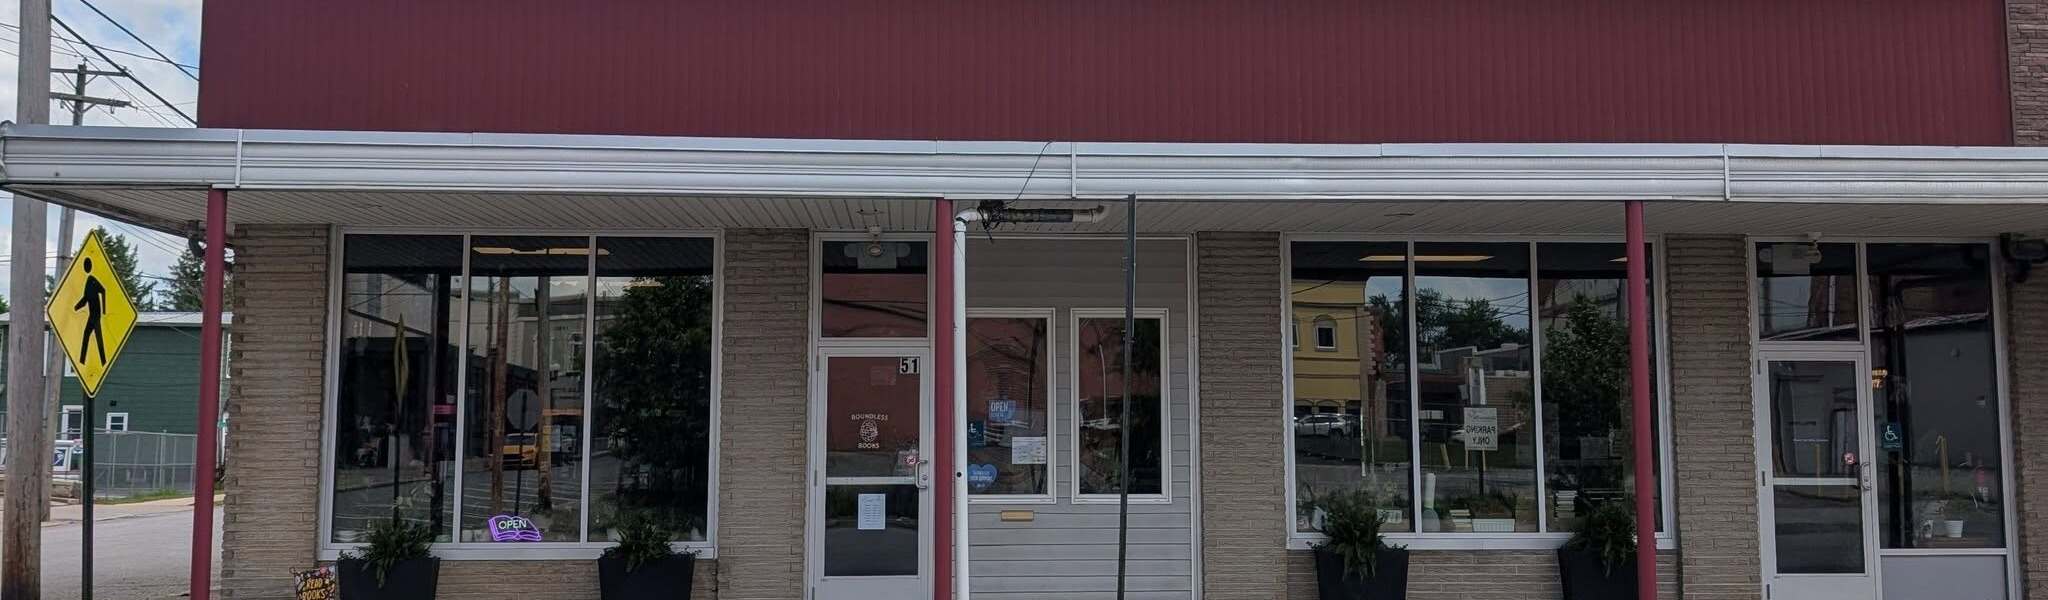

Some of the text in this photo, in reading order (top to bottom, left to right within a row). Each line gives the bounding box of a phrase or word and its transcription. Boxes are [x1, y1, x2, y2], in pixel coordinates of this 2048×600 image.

[901, 358, 918, 373] 51
[991, 401, 1009, 412] OPEN
[851, 413, 889, 421] BOUNDLESS
[498, 519, 527, 530] OPEN
[306, 577, 323, 589] READ
[302, 588, 326, 600] BOOKS
